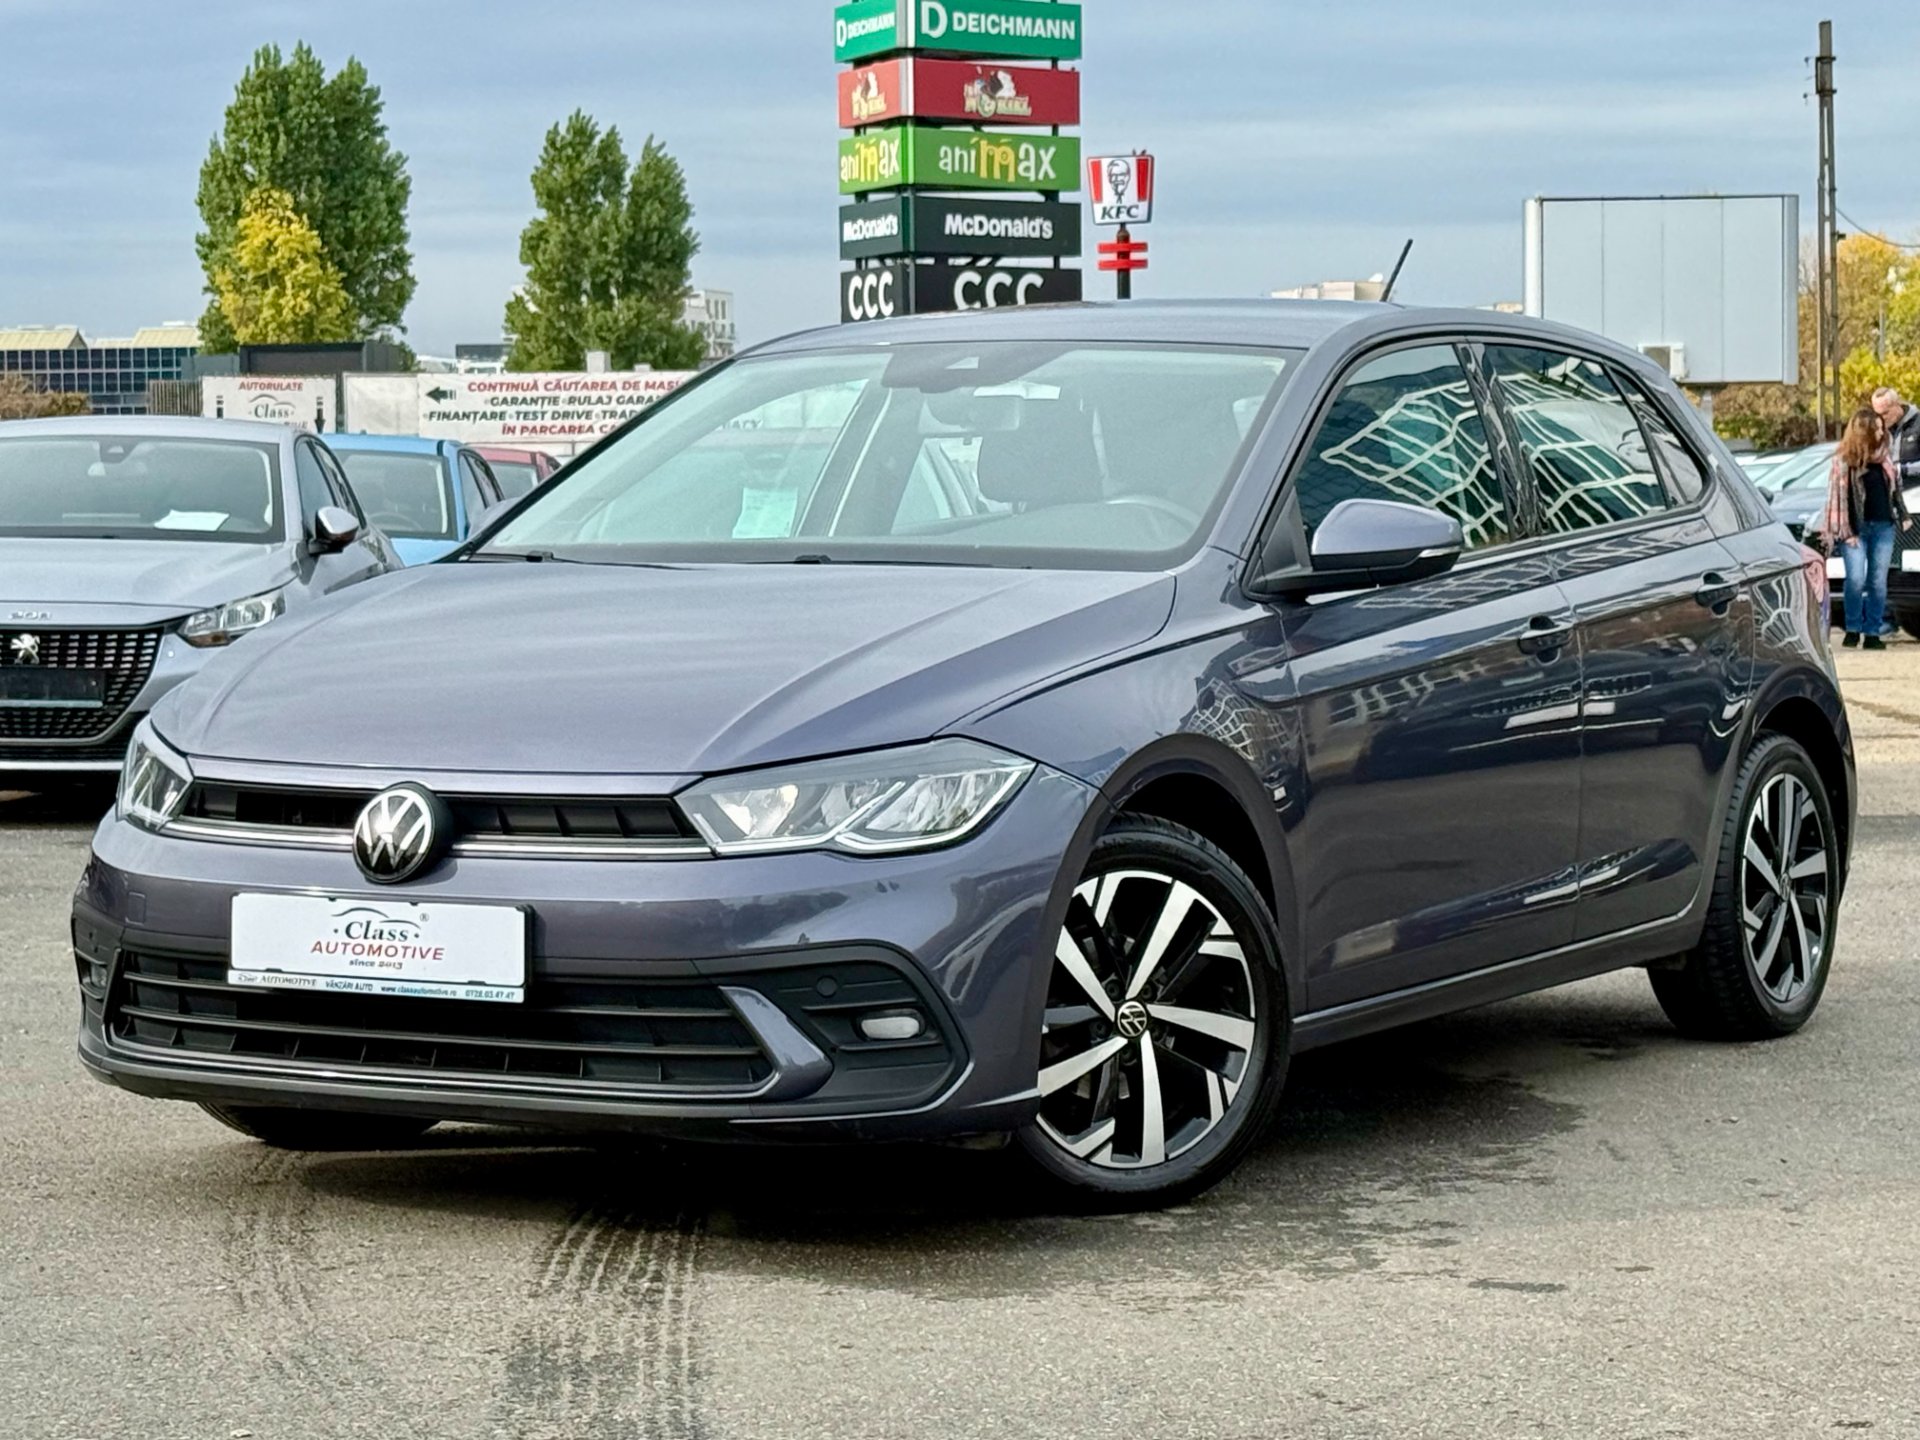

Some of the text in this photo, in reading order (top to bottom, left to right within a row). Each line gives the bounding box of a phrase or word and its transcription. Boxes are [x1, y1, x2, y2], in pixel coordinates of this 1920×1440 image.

[952, 11, 1076, 40] DEICHMANN
[939, 137, 1056, 183] animax
[1100, 205, 1140, 220] KFC
[843, 213, 899, 243] McDonald's
[945, 213, 1053, 239] McDonald's
[848, 270, 894, 321] CCC
[953, 269, 1044, 311] CCC
[238, 381, 303, 392] AUTORULATE
[467, 379, 539, 393] CONTINUĂ
[544, 378, 618, 392] CĂUTAREA
[621, 380, 640, 391] DE
[490, 395, 560, 409] GARANȚIE
[567, 395, 613, 406] RULAJ
[254, 403, 290, 419] Class
[428, 410, 507, 425] FINANȚARE
[515, 410, 547, 421] TEST
[551, 410, 594, 421] DRIVE
[501, 423, 517, 436] ÎN
[520, 424, 595, 435] PARCAREA
[345, 920, 409, 942] Class
[311, 941, 445, 961] AUTOMOTIVE
[349, 959, 376, 968] since
[261, 975, 318, 987] AUTOMOTIVE
[354, 982, 374, 992] AUTO
